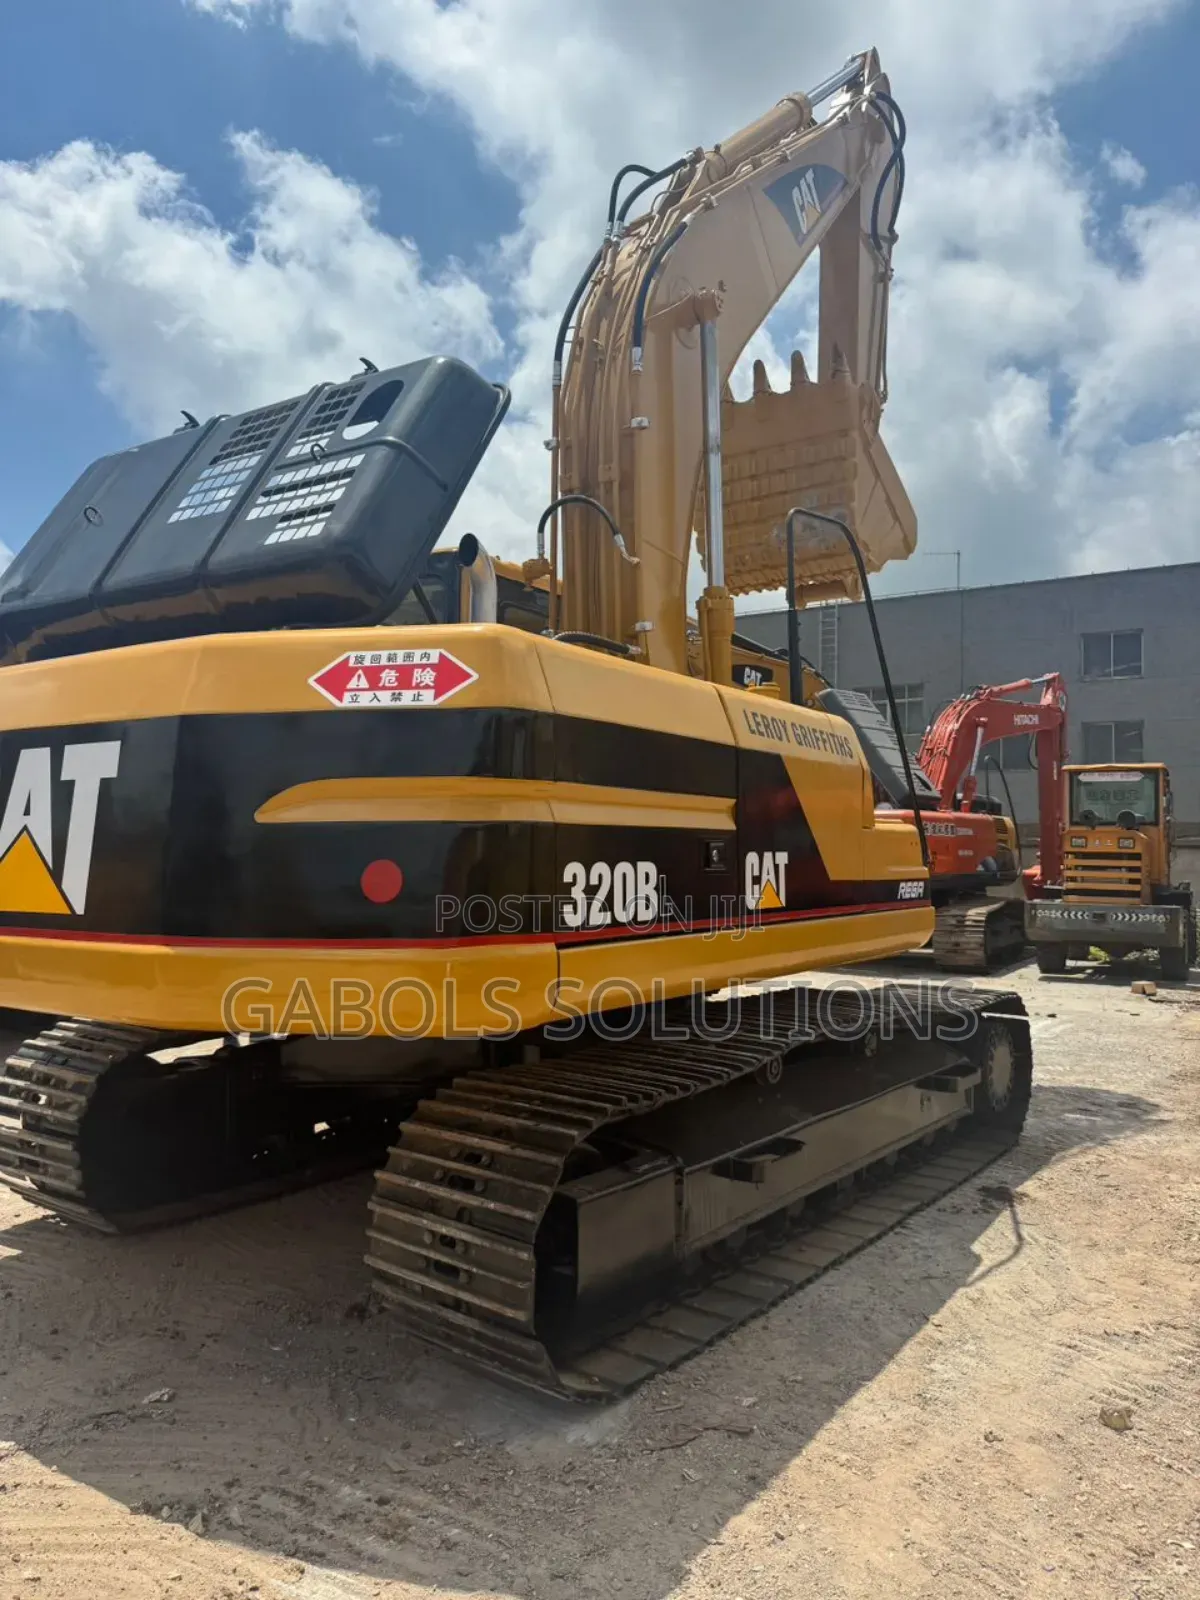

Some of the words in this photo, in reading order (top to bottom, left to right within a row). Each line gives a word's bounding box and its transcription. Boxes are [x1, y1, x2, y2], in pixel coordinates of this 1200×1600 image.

[791, 167, 821, 235] CAT
[353, 651, 431, 666] 旋回範囲内
[378, 667, 437, 688] 危険
[743, 666, 762, 687] CAT
[348, 691, 424, 704] 立入禁止
[1013, 713, 1040, 726] HITACHI
[743, 709, 790, 743] LEROY
[790, 721, 854, 760] GRIFFITHS
[744, 851, 789, 911] CAT
[562, 860, 659, 928] 320B
